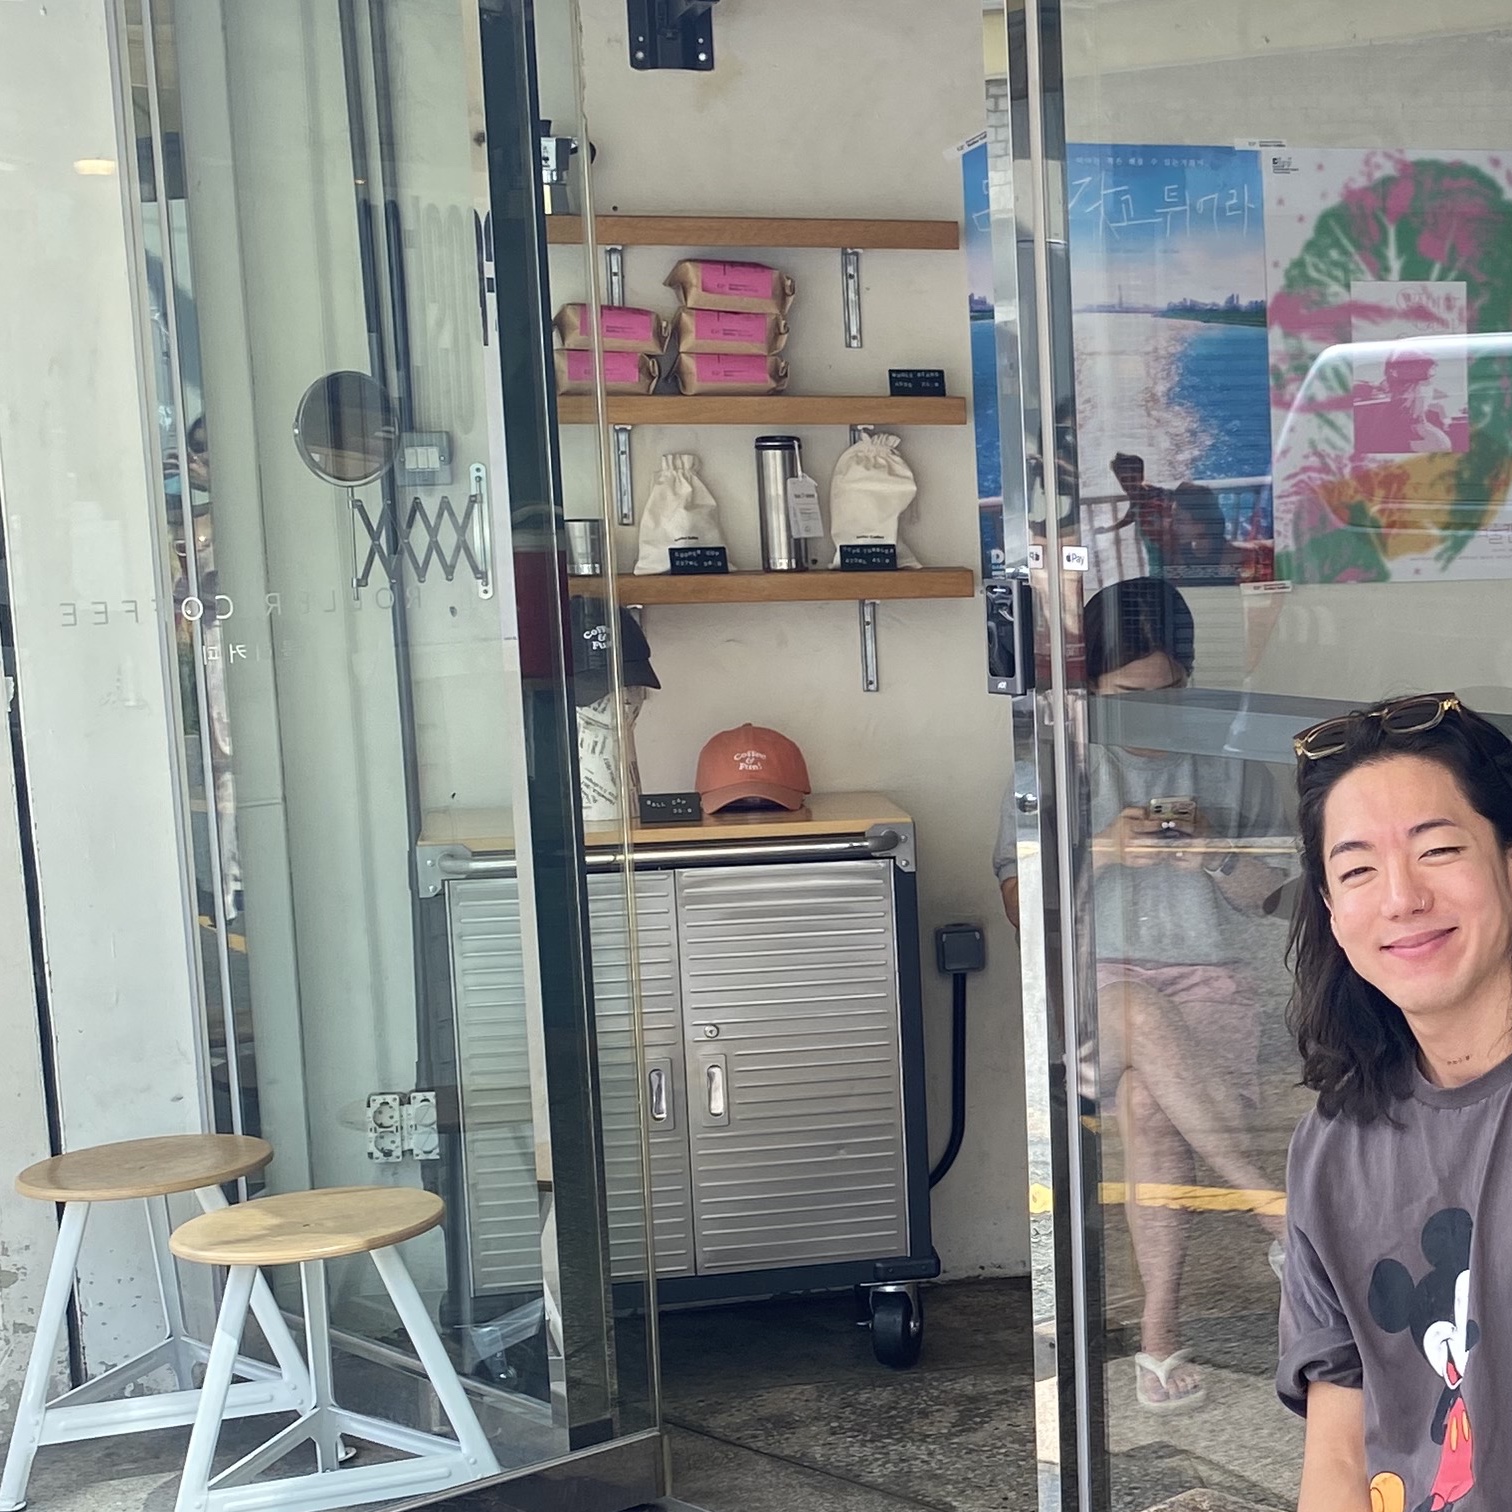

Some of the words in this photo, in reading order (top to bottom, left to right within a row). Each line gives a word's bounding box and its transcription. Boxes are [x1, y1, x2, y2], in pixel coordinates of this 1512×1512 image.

[1155, 183, 1256, 239] 튀어라
[1071, 553, 1085, 565] Pay
[733, 750, 767, 761] Coffee
